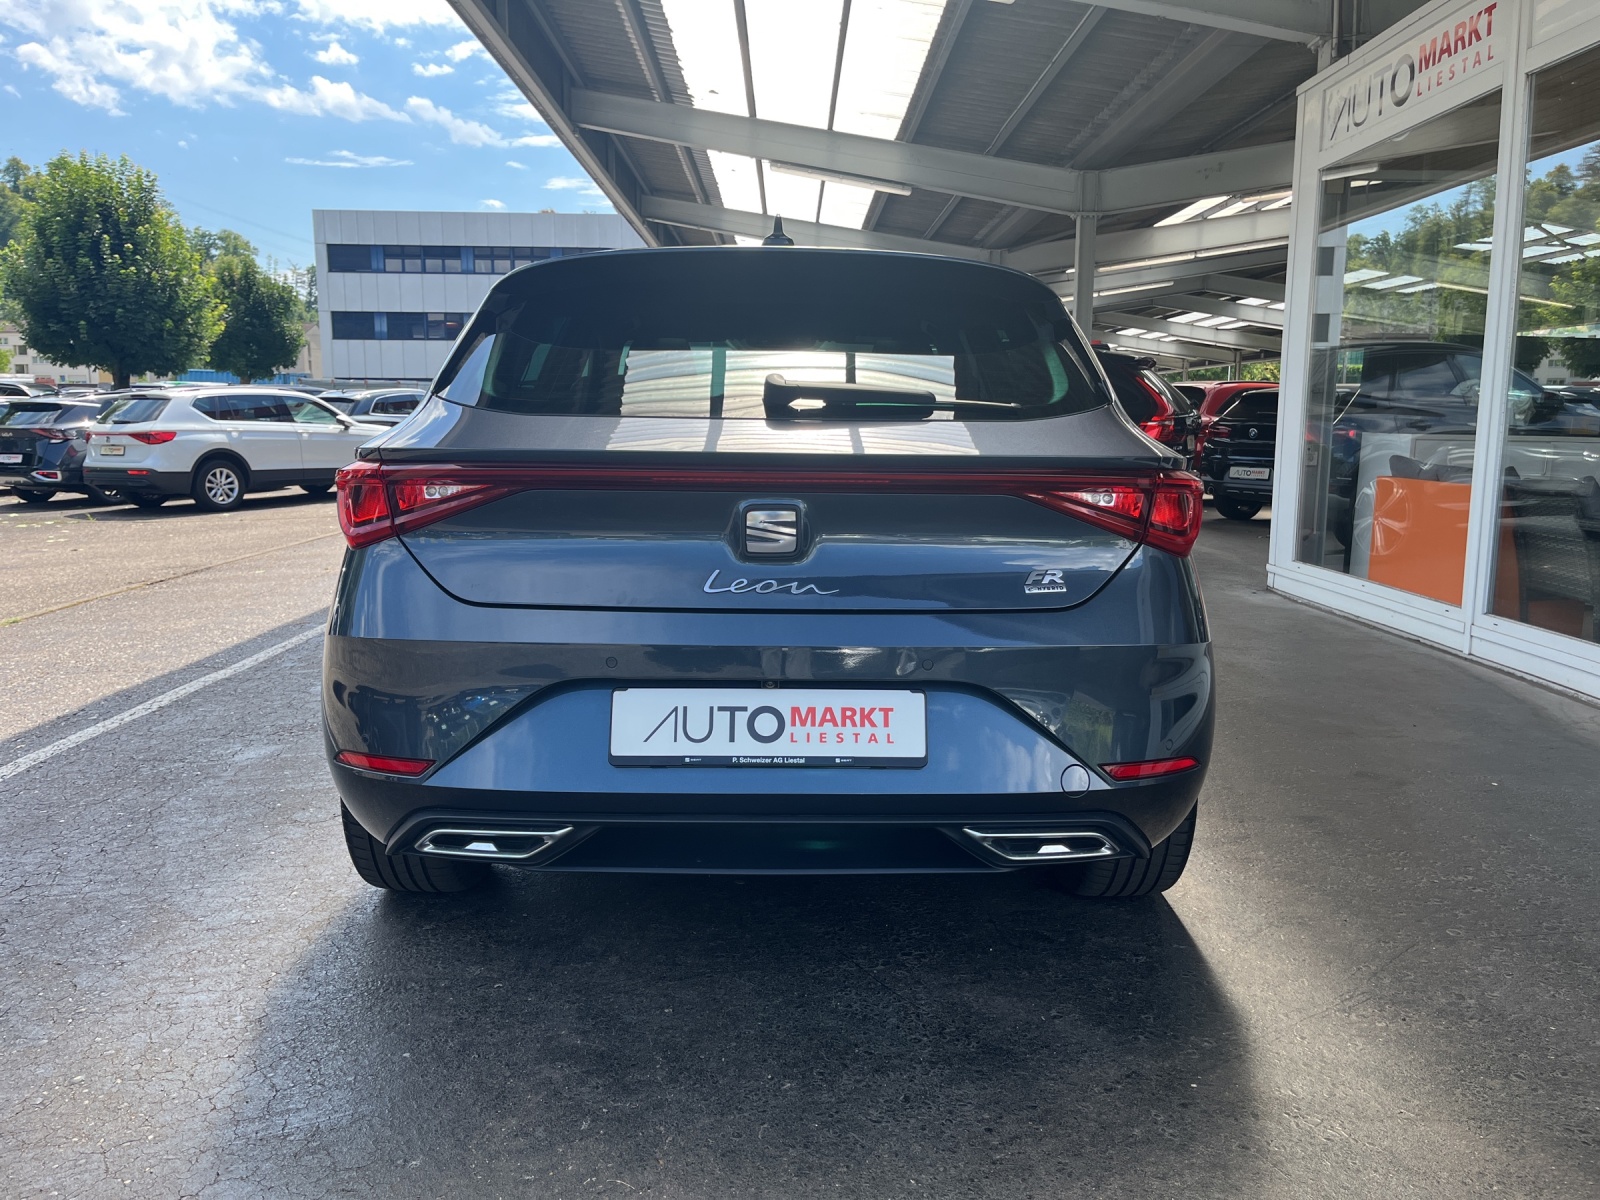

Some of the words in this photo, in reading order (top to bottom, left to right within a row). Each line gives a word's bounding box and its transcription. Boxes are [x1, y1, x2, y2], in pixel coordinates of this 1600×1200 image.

[1330, 53, 1415, 141] AUTO
[1418, 2, 1497, 74] MARKT
[1416, 44, 1494, 97] LIESTAL
[703, 569, 839, 595] Leon
[1025, 569, 1065, 585] FR
[643, 705, 786, 743] AUTO
[790, 706, 894, 727] MARKT
[790, 732, 895, 744] LIESTAL
